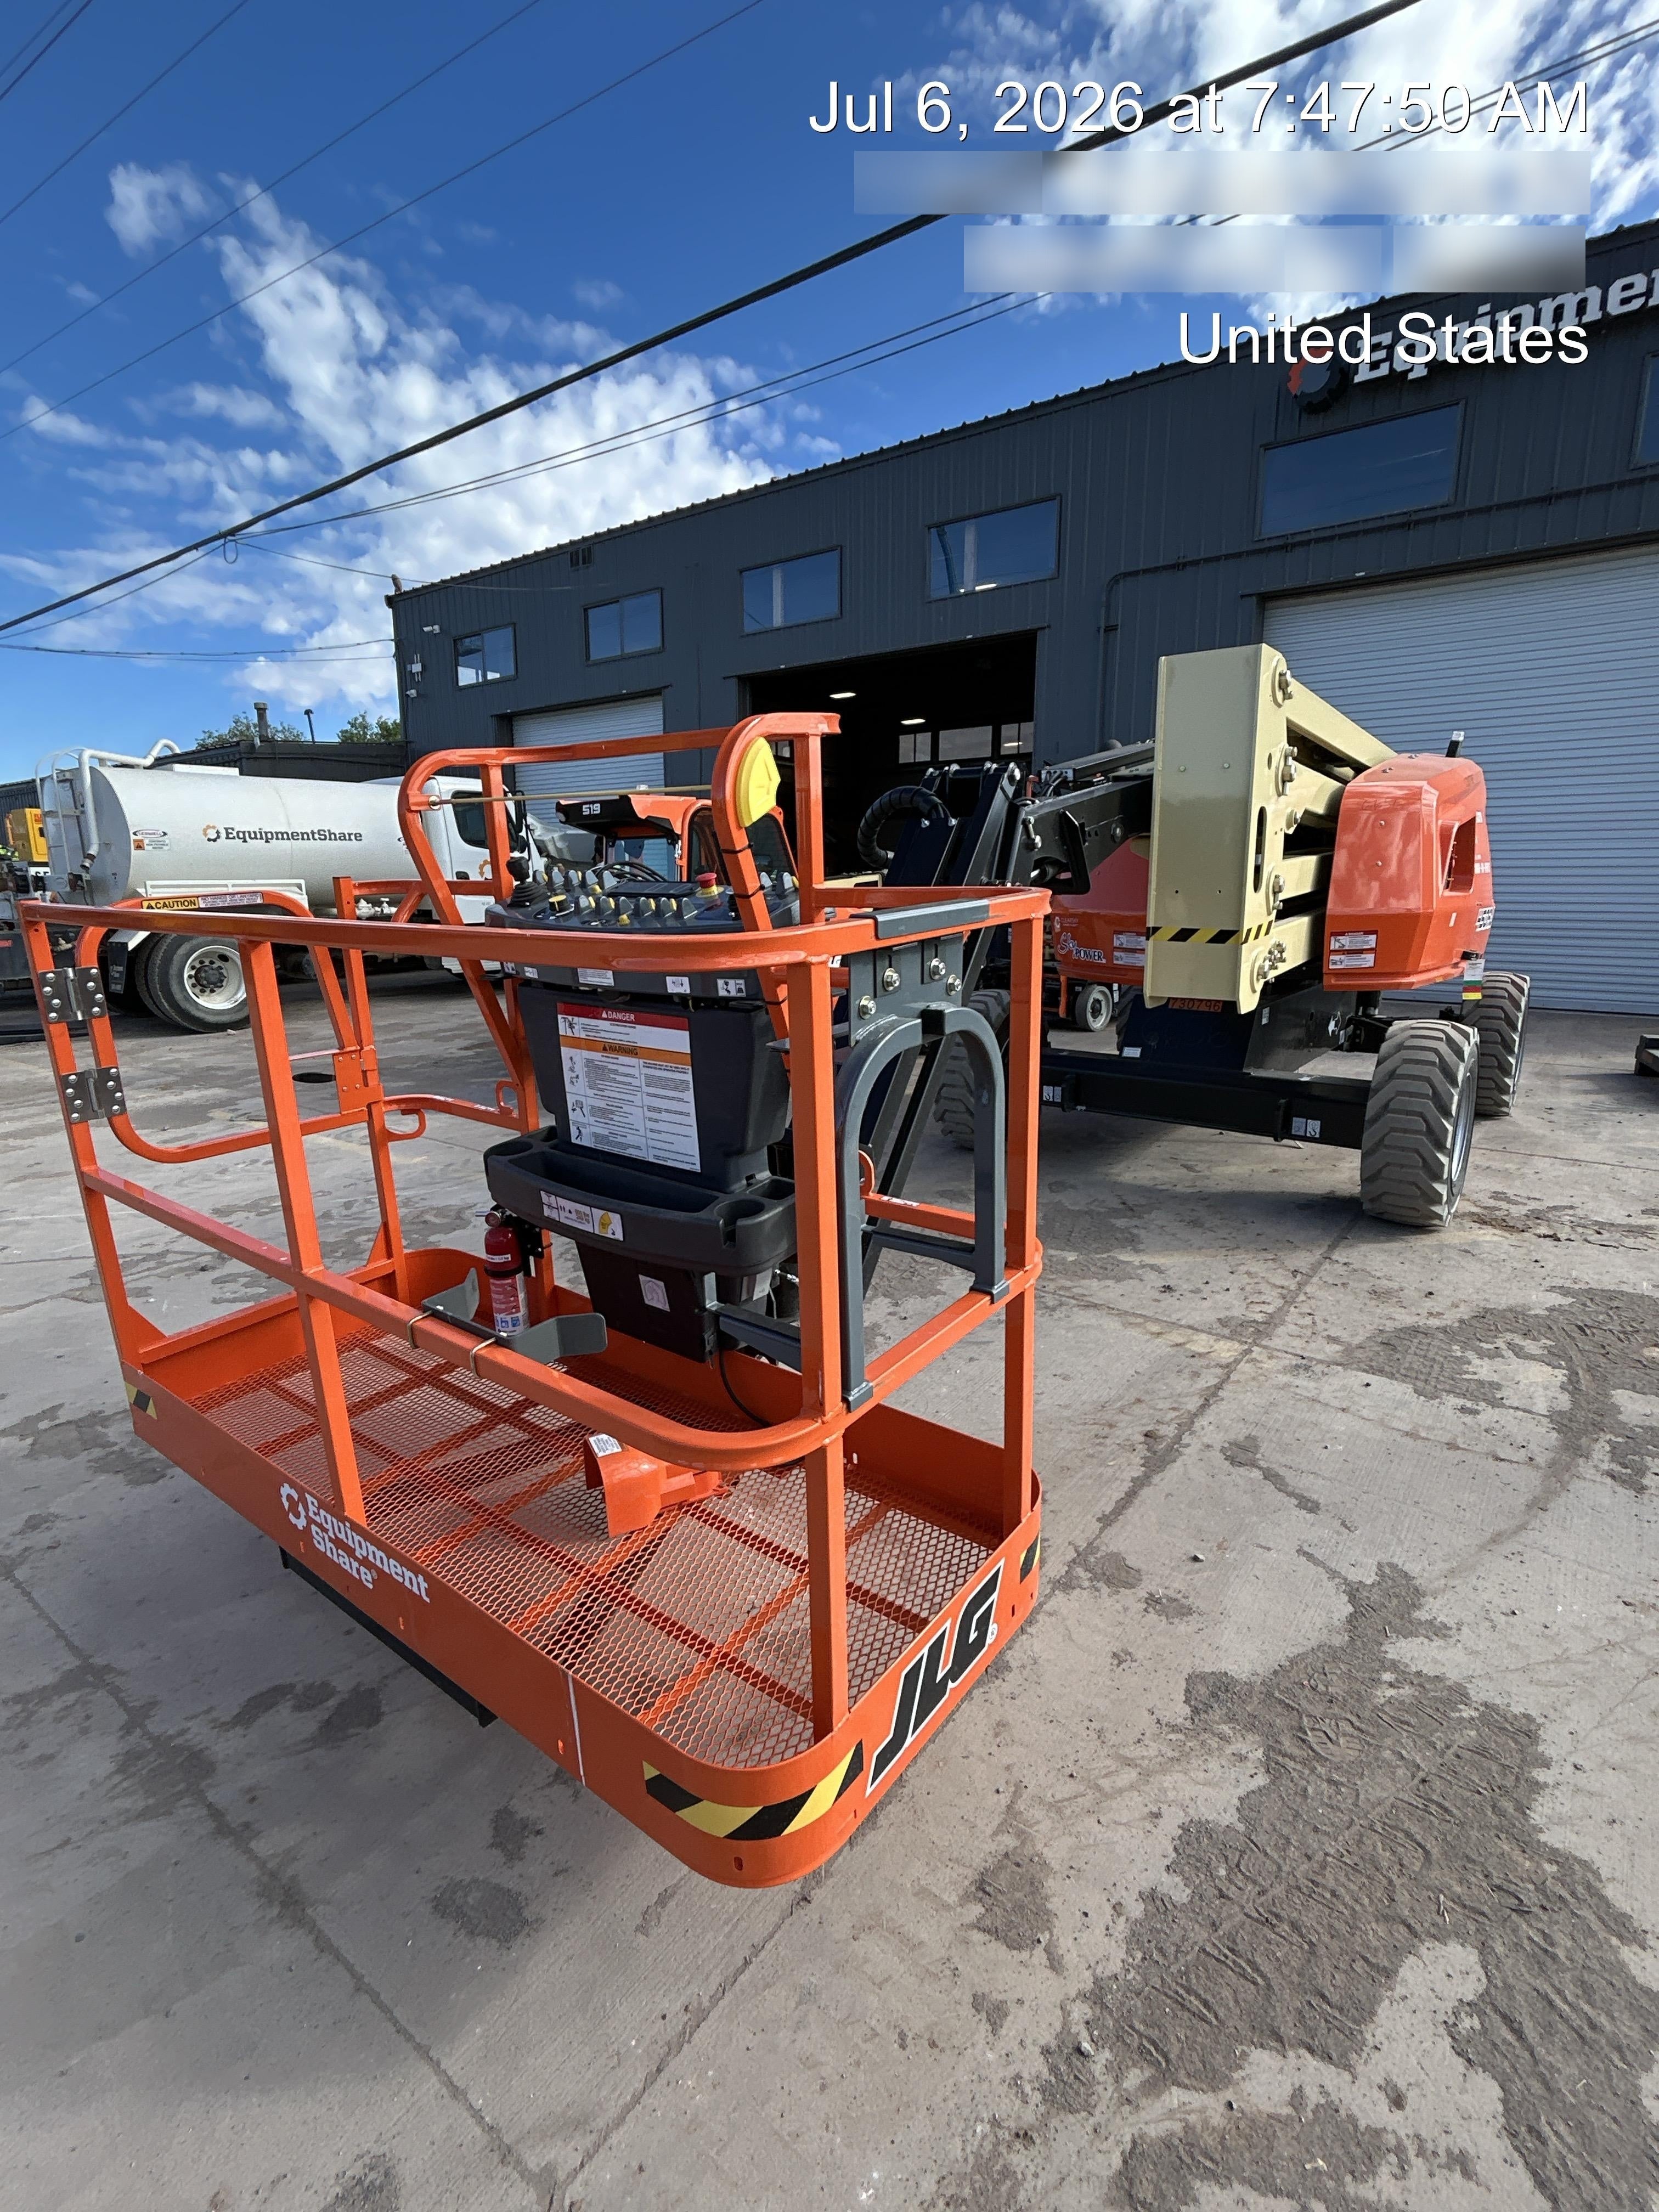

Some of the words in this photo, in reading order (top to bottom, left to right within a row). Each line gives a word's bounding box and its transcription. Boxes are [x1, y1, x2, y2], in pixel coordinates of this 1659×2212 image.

[583, 803, 601, 815] 519
[223, 827, 363, 843] EquipmentShare
[155, 899, 196, 910] CAUTION
[1074, 947, 1104, 962] POWER
[1171, 998, 1221, 1012] 730796
[608, 1011, 635, 1022] DANGER
[608, 1045, 638, 1056] WARNING
[305, 1493, 431, 1603] Equipment
[311, 1523, 374, 1589] Share
[866, 1559, 1004, 1797] JLG
